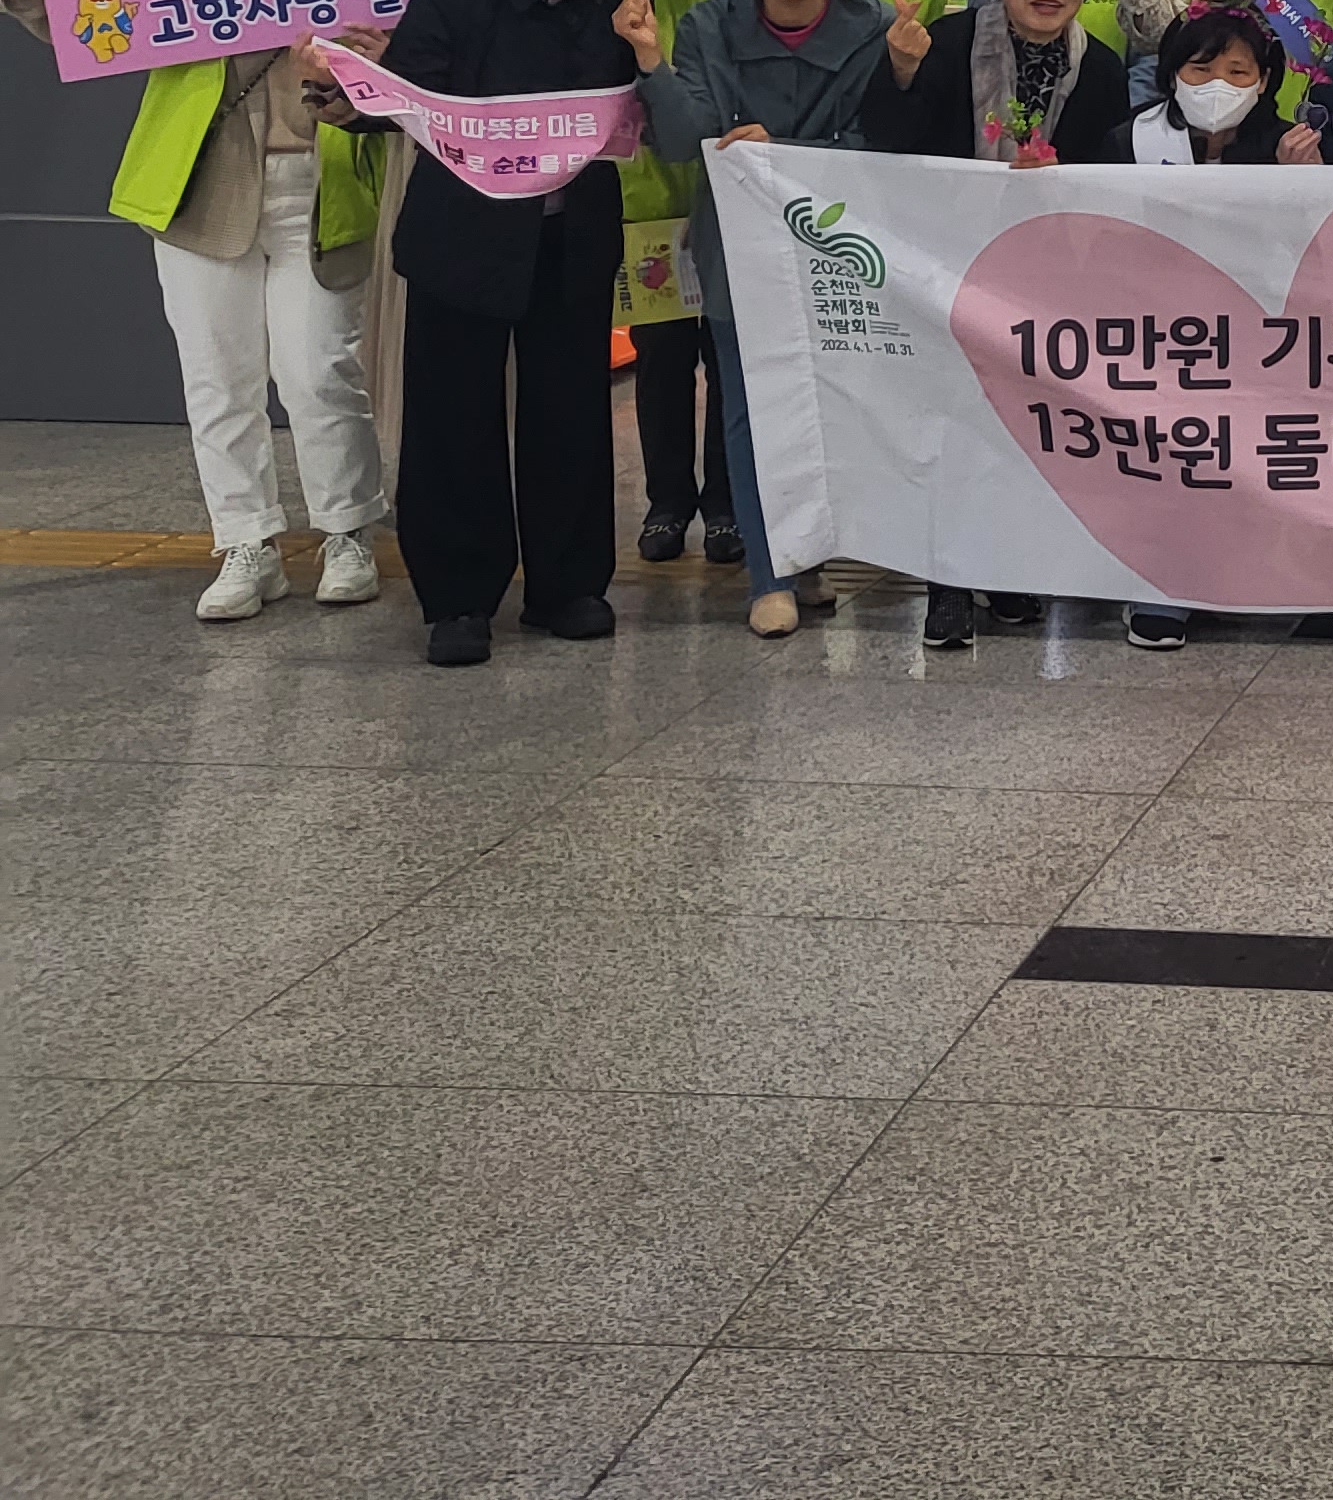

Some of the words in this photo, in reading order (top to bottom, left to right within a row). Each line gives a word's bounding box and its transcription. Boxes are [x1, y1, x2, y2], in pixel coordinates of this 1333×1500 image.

[547, 113, 598, 139] 마음
[811, 279, 861, 296] 순천만
[813, 299, 881, 316] 국제정원
[817, 318, 867, 336] 박람회
[1009, 315, 1233, 391] 10만원
[1026, 401, 1233, 490] 13만원
